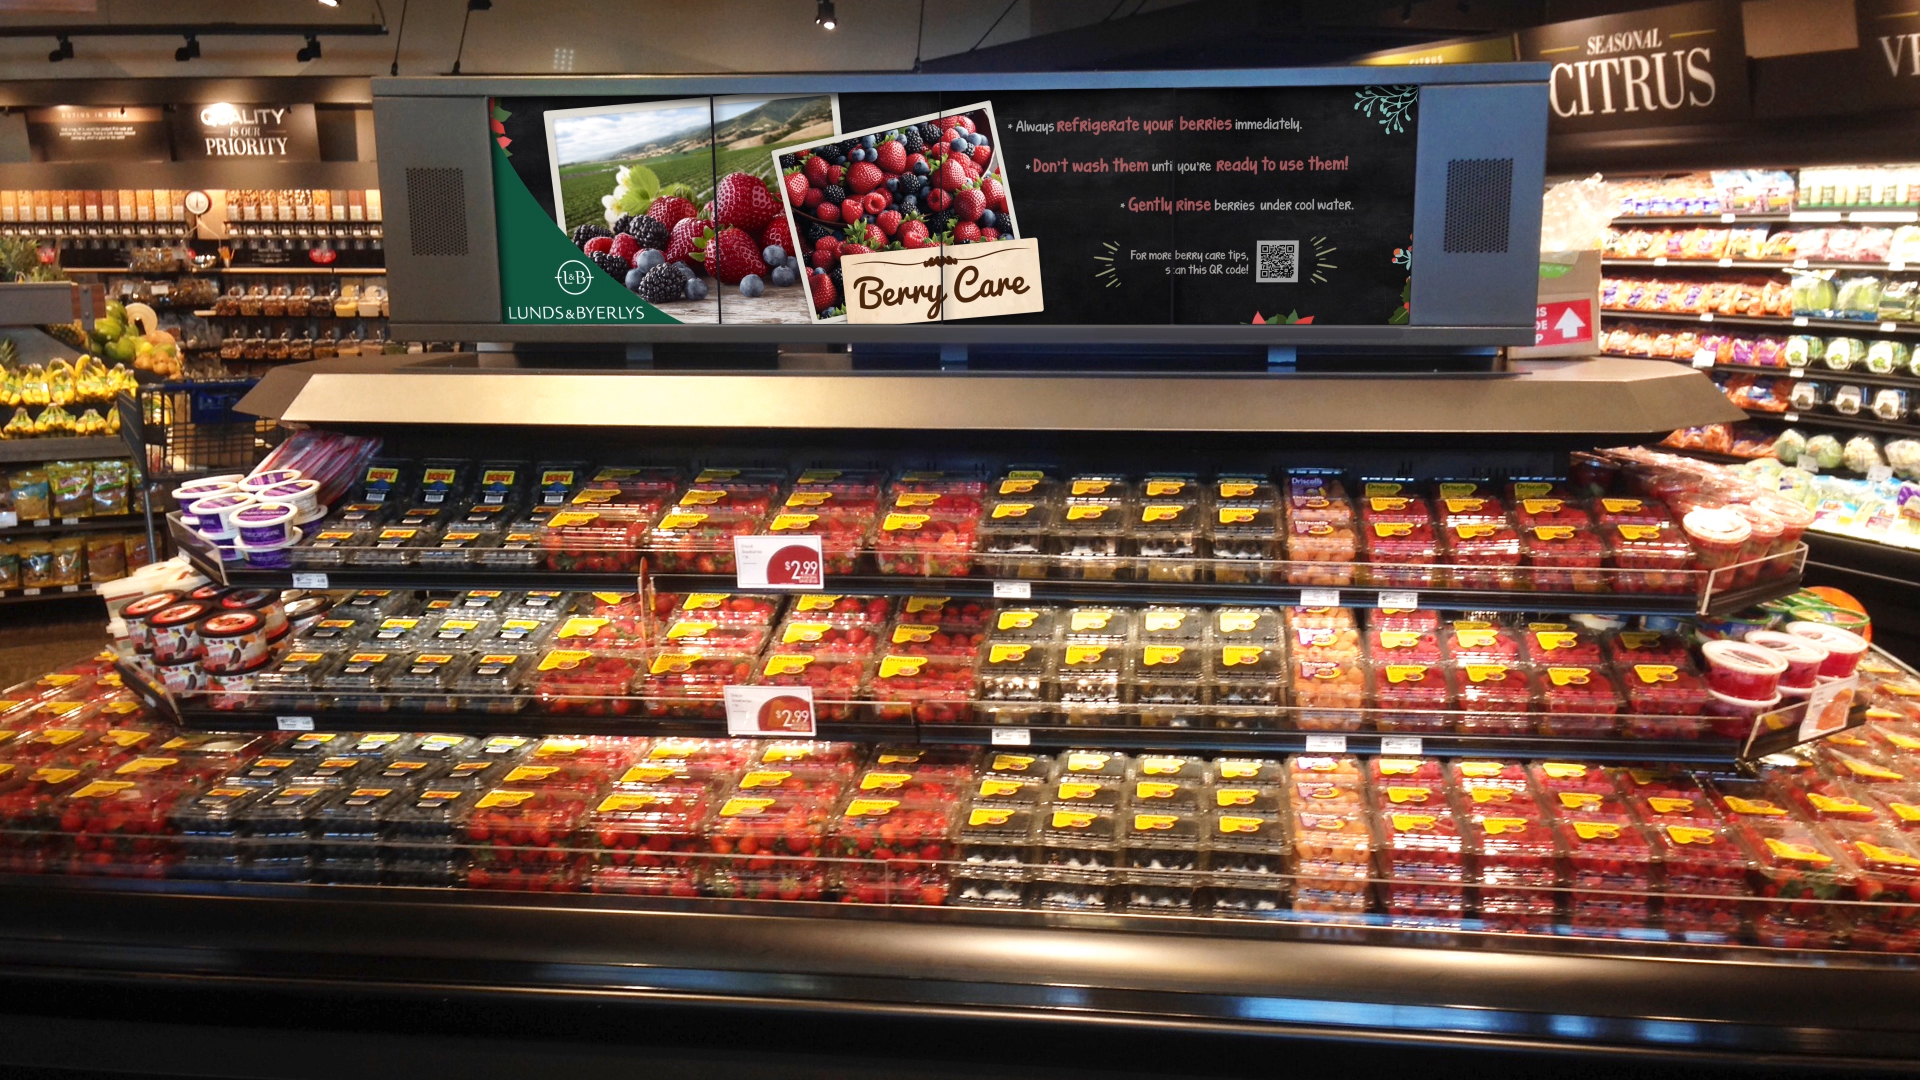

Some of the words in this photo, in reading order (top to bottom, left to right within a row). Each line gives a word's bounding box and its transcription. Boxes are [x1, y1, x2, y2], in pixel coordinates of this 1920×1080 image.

[1586, 28, 1662, 55] SEASONAL
[1549, 47, 1716, 118] CITRUS
[229, 126, 239, 137] IS
[240, 126, 261, 137] OUR
[1015, 120, 1055, 135] Always
[1056, 116, 1140, 136] refrigerate
[1179, 116, 1233, 131] berries
[1235, 117, 1303, 133] immediately.
[205, 137, 288, 156] PRIORITY
[1033, 157, 1069, 173] Don't
[1072, 157, 1109, 173] wash
[1112, 157, 1149, 173] them
[1151, 160, 1174, 172] unti
[1216, 156, 1258, 175] ready
[1261, 156, 1277, 171] to
[1279, 159, 1305, 171] use
[1308, 155, 1349, 171] them!
[1128, 197, 1173, 215] Gently
[1175, 198, 1212, 211] rinse
[1214, 199, 1256, 211] berries
[1260, 200, 1293, 211] under
[1295, 198, 1315, 211] cool
[1317, 198, 1354, 211] water.
[1130, 249, 1148, 260] For
[1149, 252, 1172, 260] more
[1174, 250, 1204, 262] berry
[1205, 252, 1226, 260] care
[1228, 250, 1249, 261] tips,
[562, 270, 587, 285] L&B
[1165, 265, 1187, 275] san
[1188, 264, 1208, 275] this
[1209, 264, 1224, 275] QR
[1225, 264, 1249, 275] code!
[853, 275, 948, 320] Berry
[953, 265, 1031, 303] Care
[508, 305, 645, 320] LUNDS&BYERLYS
[785, 560, 818, 580] $2.99
[775, 709, 809, 727] $2.99
